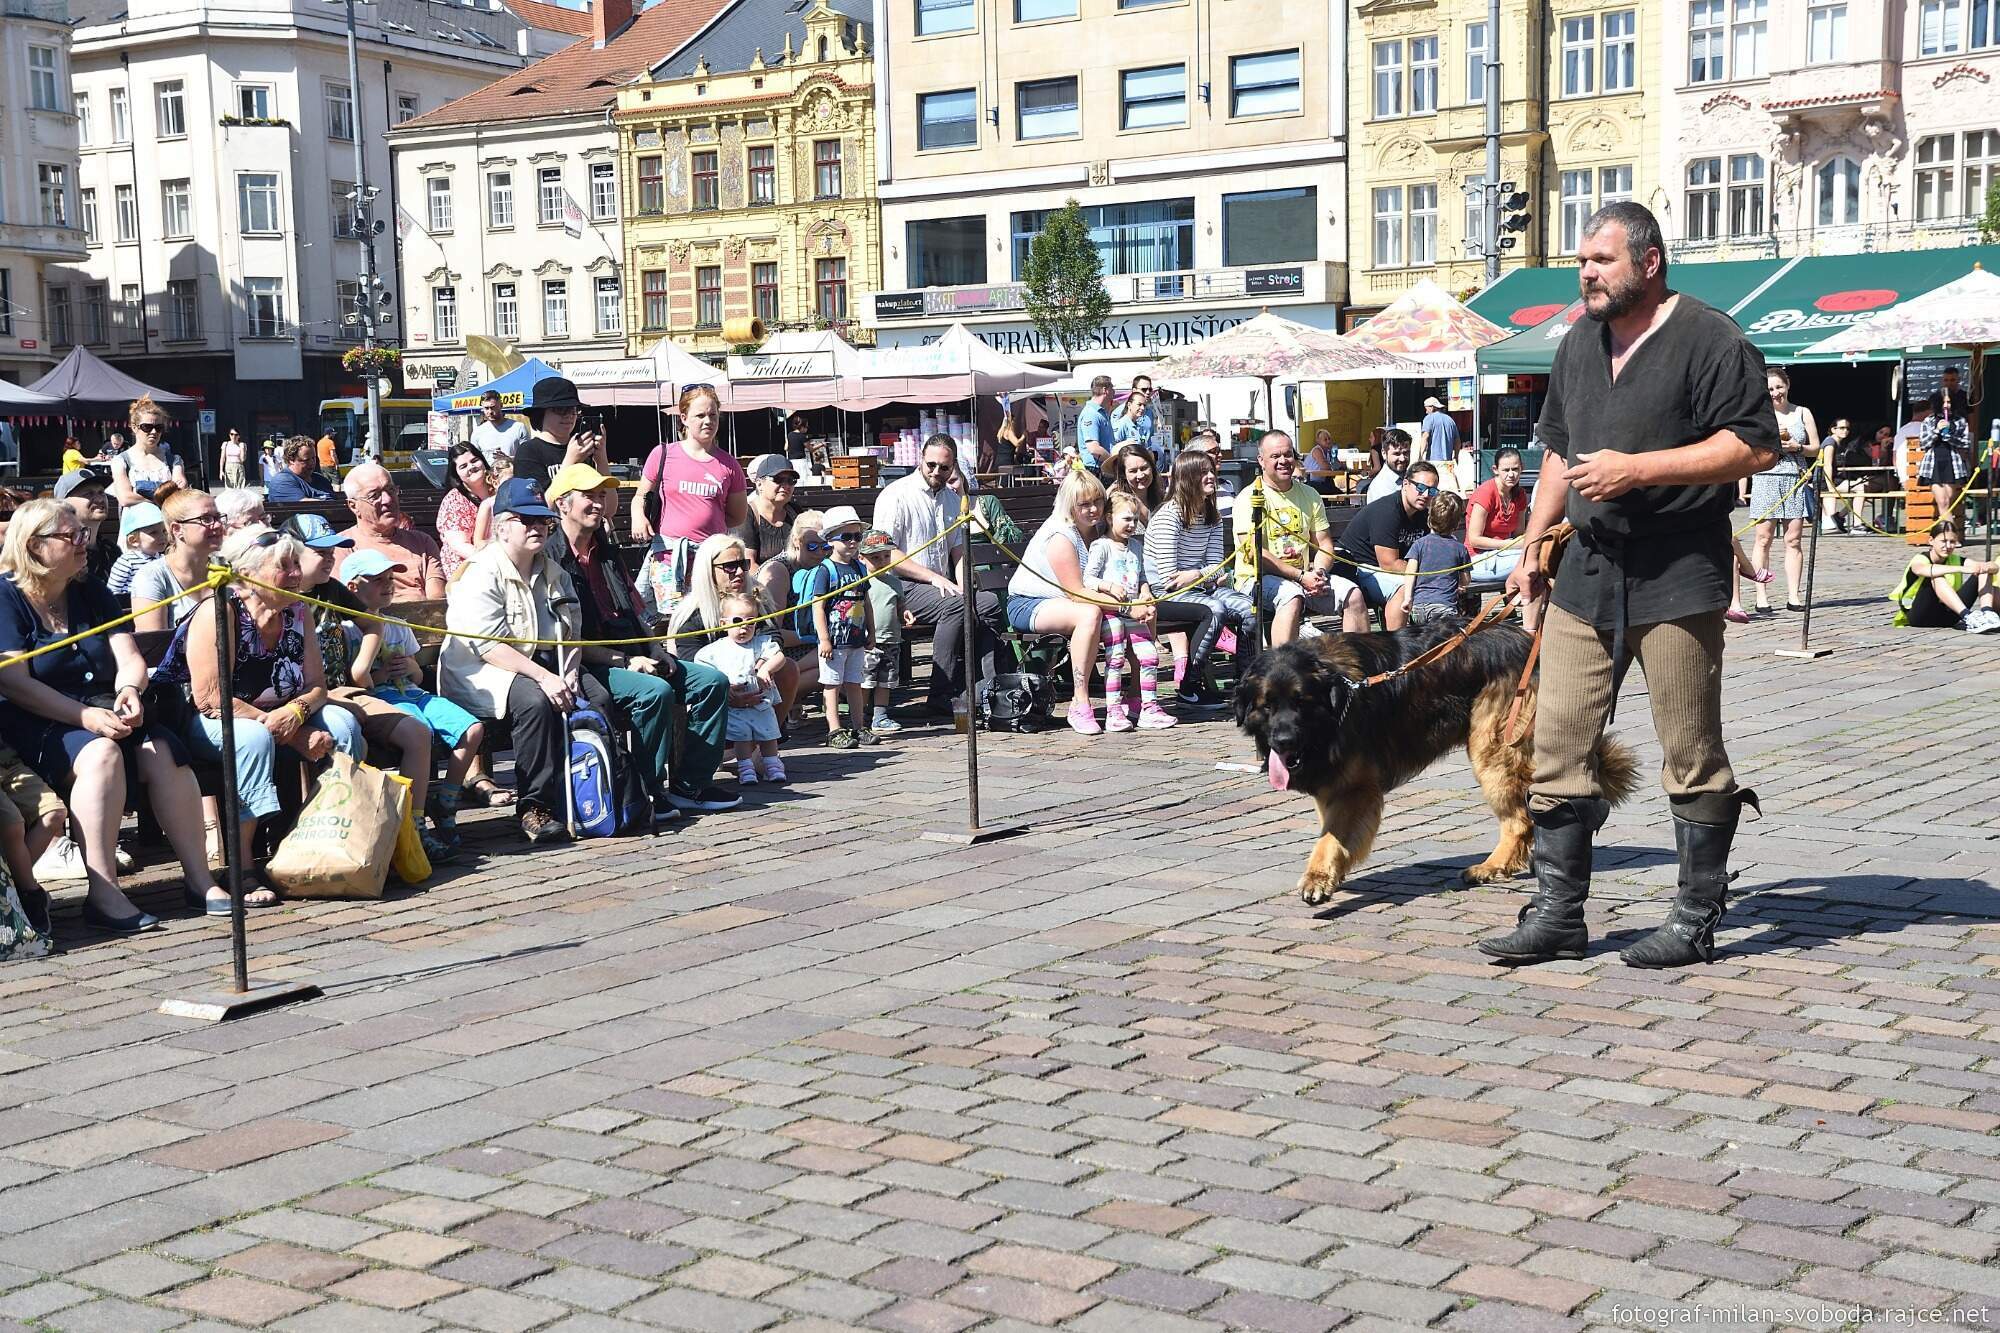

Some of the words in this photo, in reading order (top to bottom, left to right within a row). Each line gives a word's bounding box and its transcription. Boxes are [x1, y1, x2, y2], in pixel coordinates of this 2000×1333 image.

[1268, 273, 1300, 286] Strejc
[454, 398, 477, 409] MAXI
[678, 479, 718, 497] PUMA
